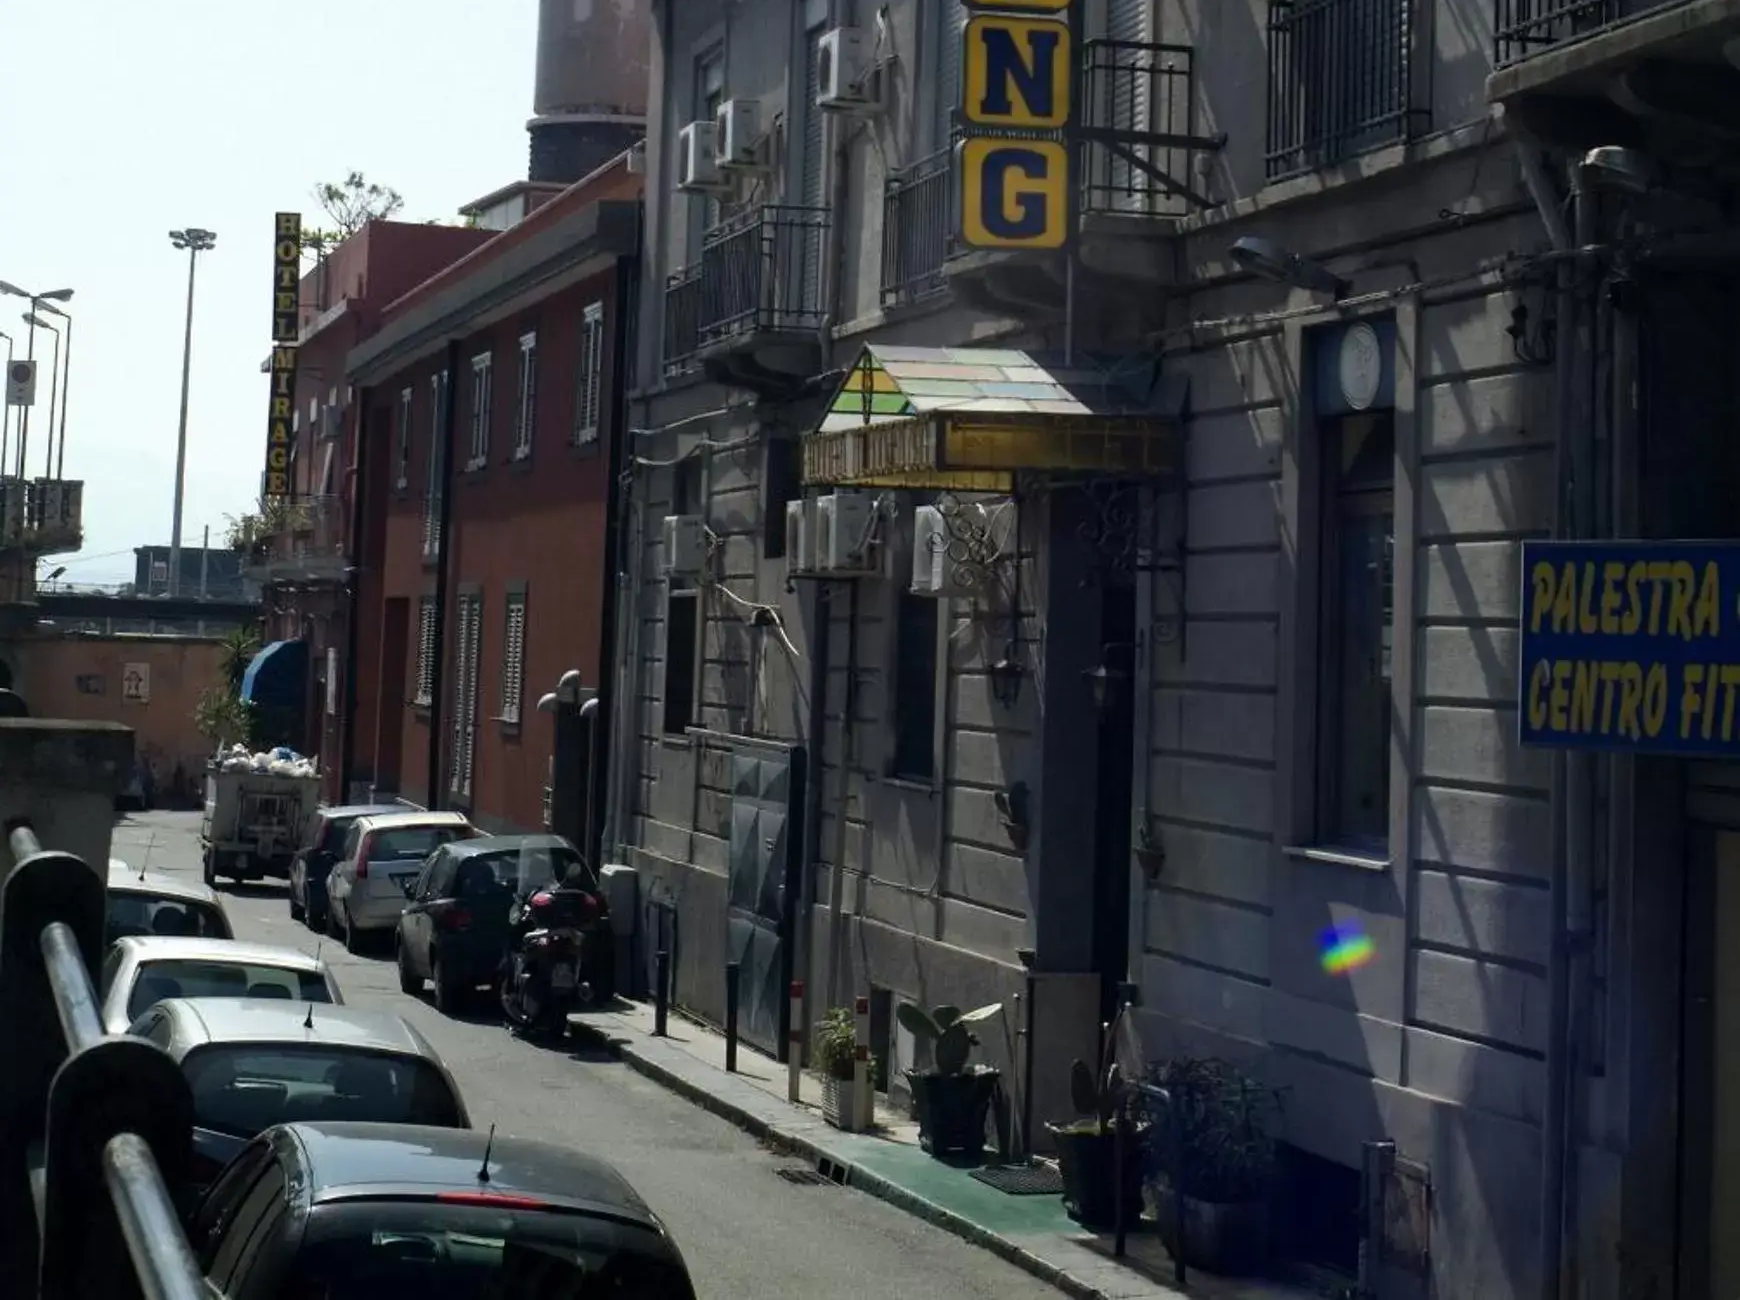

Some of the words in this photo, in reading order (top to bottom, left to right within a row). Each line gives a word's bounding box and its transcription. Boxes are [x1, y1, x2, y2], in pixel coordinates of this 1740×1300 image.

[276, 214, 298, 339] HOTEL
[268, 348, 295, 494] MIRAGE
[1531, 560, 1720, 641] PALESTRA
[1528, 657, 1668, 742] CENTRO
[1680, 663, 1740, 741] FIT
